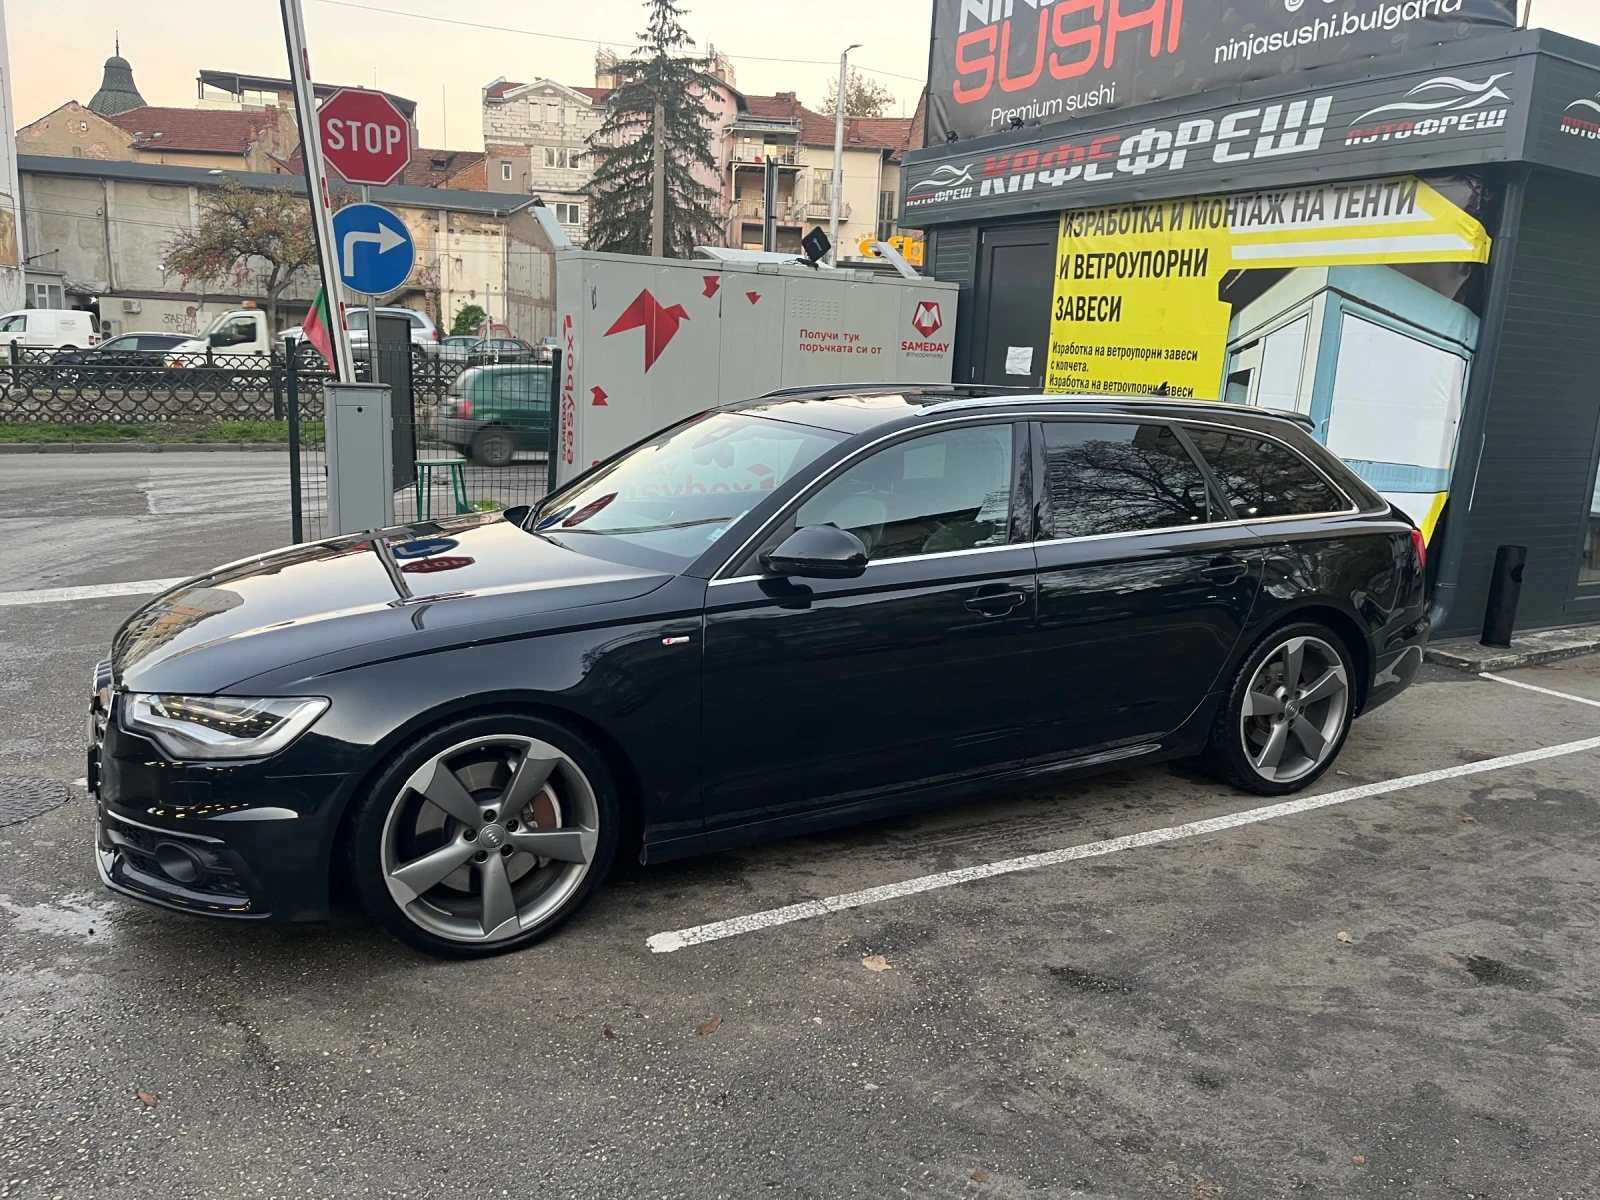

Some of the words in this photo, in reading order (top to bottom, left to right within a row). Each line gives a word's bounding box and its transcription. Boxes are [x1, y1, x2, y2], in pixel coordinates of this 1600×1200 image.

[952, 0, 1184, 105] SUSHI
[990, 99, 1063, 127] Premium
[1066, 82, 1117, 111] sushi
[327, 118, 401, 155] STOP
[1063, 204, 1164, 238] ИЗРАБОТКА
[1169, 203, 1186, 232] И
[1189, 192, 1289, 230] МОНТАЖ
[1291, 188, 1325, 223] НА
[1334, 180, 1419, 220] ТЕНТИ
[1059, 254, 1069, 280] И
[1074, 247, 1209, 280] ВЕТРОУПОРНИ
[1055, 295, 1122, 323] ЗАВЕСИ
[799, 328, 839, 342] Получи
[843, 333, 860, 343] тук
[799, 343, 853, 353] поръчката
[856, 346, 868, 354] си
[870, 346, 882, 354] от
[901, 341, 950, 352] SAMEDAY
[1052, 341, 1093, 357] Изработка
[1095, 345, 1105, 356] на
[1106, 346, 1162, 362] ветроупорни
[1164, 348, 1198, 362] завеси
[1050, 360, 1055, 370] с
[1056, 360, 1089, 373] копчета.
[565, 334, 575, 465] easybox
[1049, 373, 1090, 387] Изработка
[1091, 380, 1101, 390] на
[1164, 386, 1194, 398] авеси
